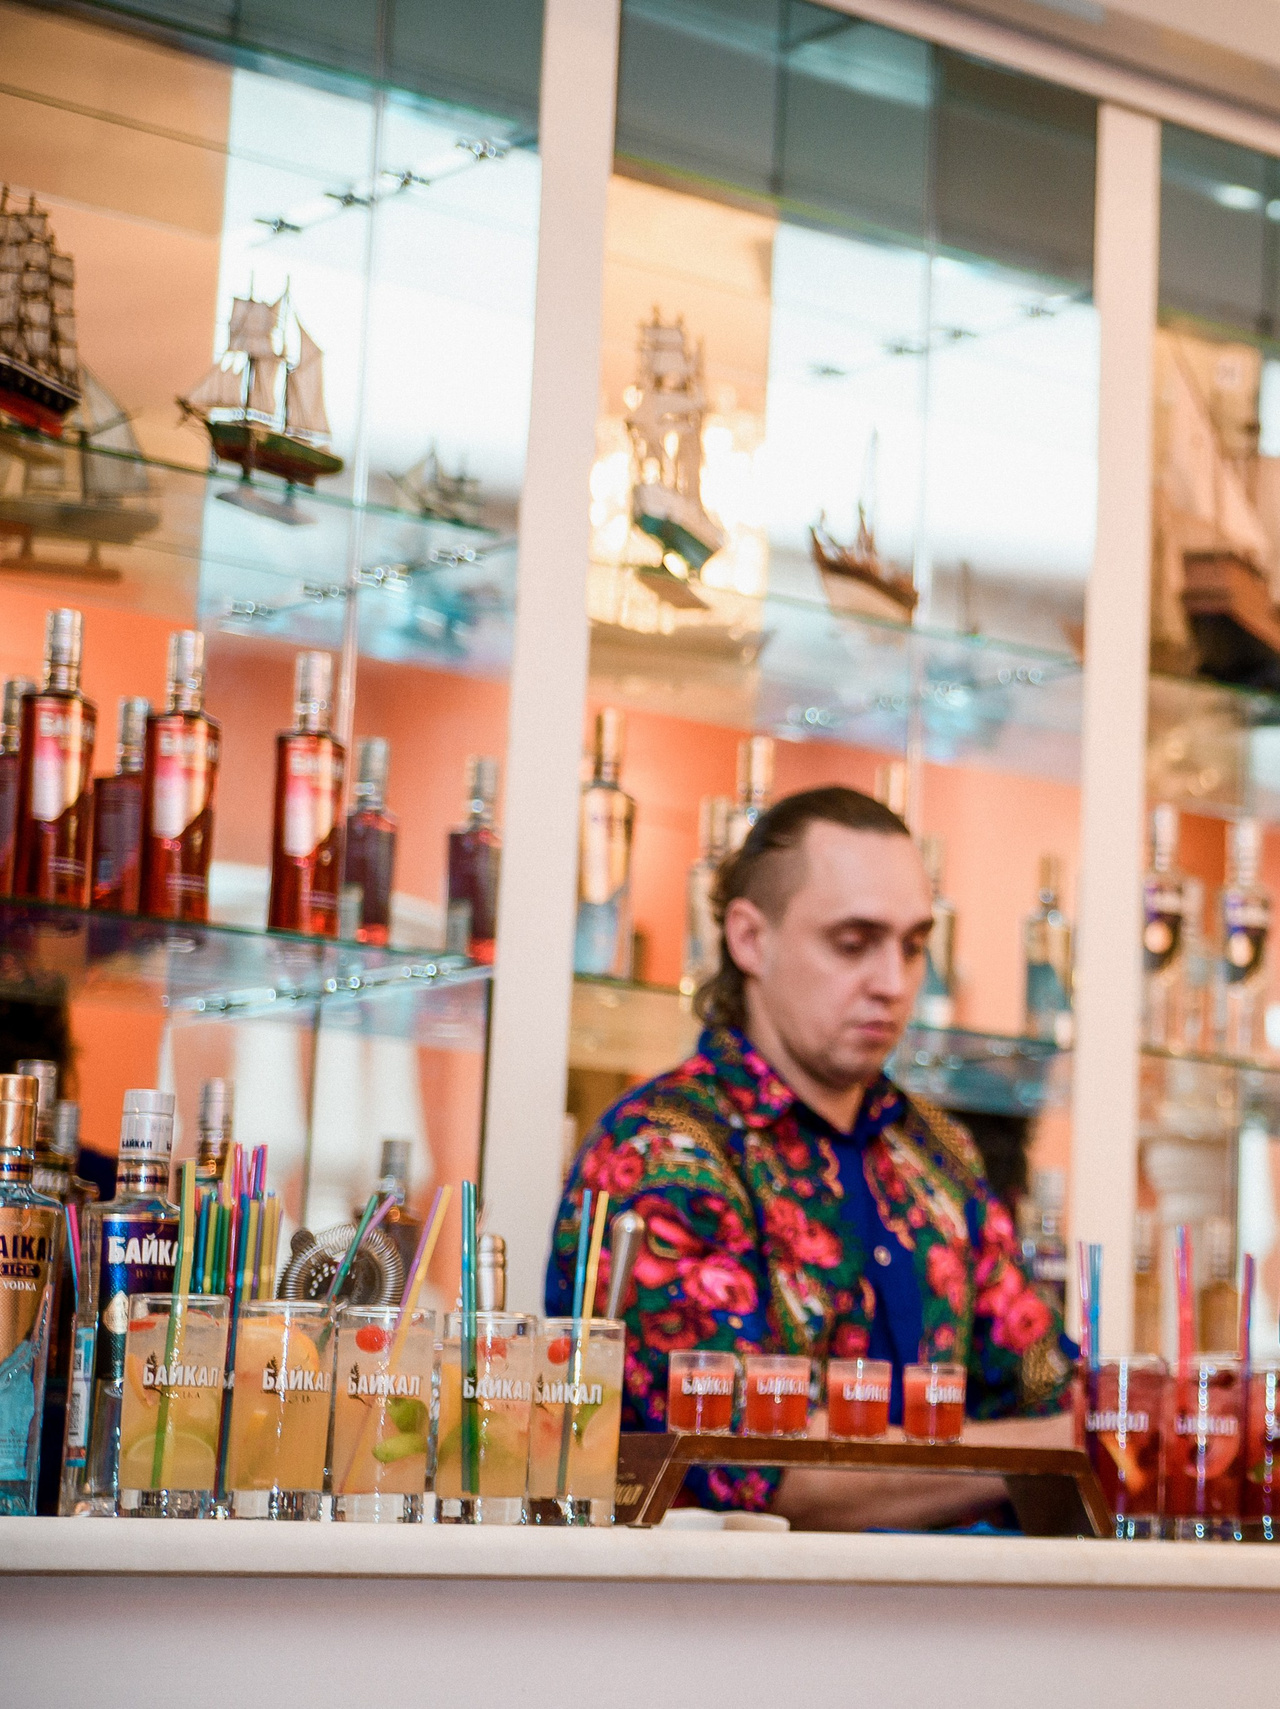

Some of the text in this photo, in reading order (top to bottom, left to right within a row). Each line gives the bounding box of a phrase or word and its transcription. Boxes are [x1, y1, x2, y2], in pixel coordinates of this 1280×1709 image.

[108, 1232, 179, 1266] БАЙК
[3, 1280, 37, 1291] VODKA
[142, 1361, 219, 1387] БАЙКАЛ
[347, 1373, 420, 1396] БАЙКАЛ
